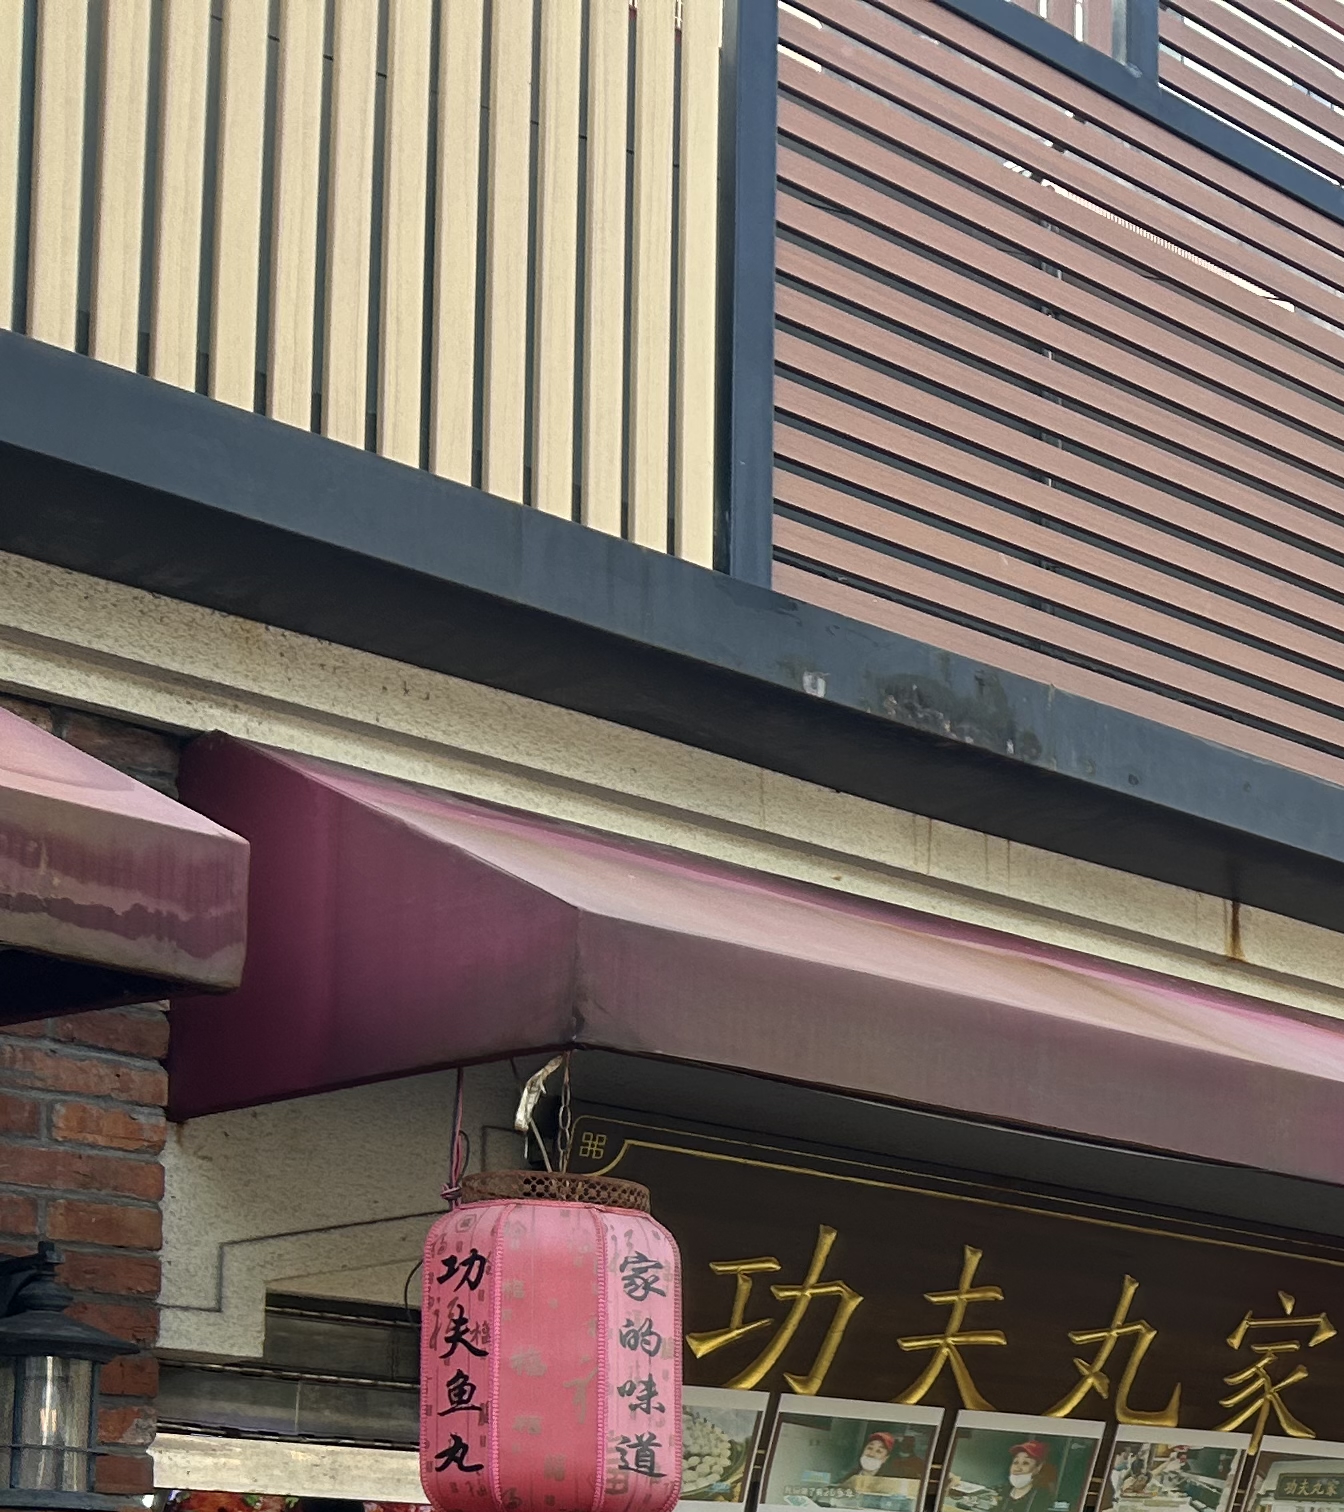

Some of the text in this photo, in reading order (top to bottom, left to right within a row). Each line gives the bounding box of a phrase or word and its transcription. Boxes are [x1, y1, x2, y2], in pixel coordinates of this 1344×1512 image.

[435, 1248, 490, 1473] 功夫鱼丸
[615, 1250, 667, 1478] 家的味道
[687, 1223, 1337, 1455] 功夫丸家
